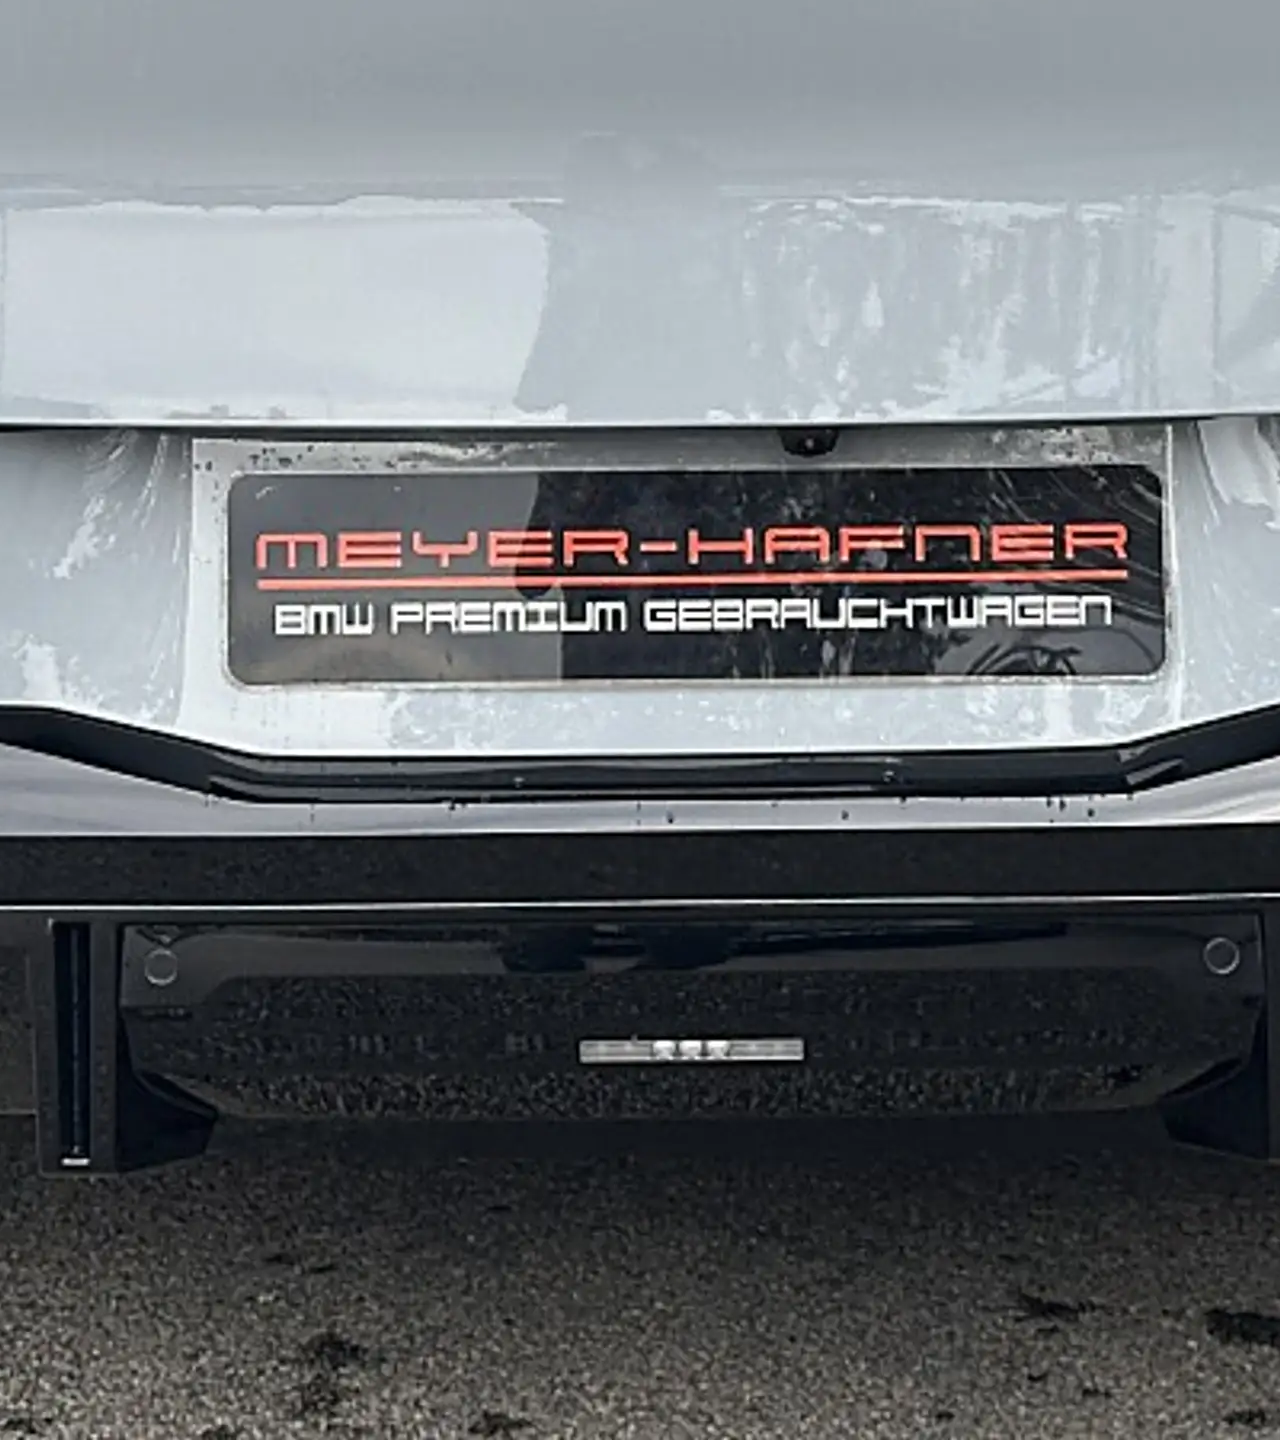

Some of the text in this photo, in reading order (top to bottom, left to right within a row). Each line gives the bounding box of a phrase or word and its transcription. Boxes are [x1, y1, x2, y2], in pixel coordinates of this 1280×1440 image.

[256, 524, 1128, 570] MEYER-HAFNER
[274, 595, 1113, 636] BMW PREMIUM GEBRAUCHTWAGEN
